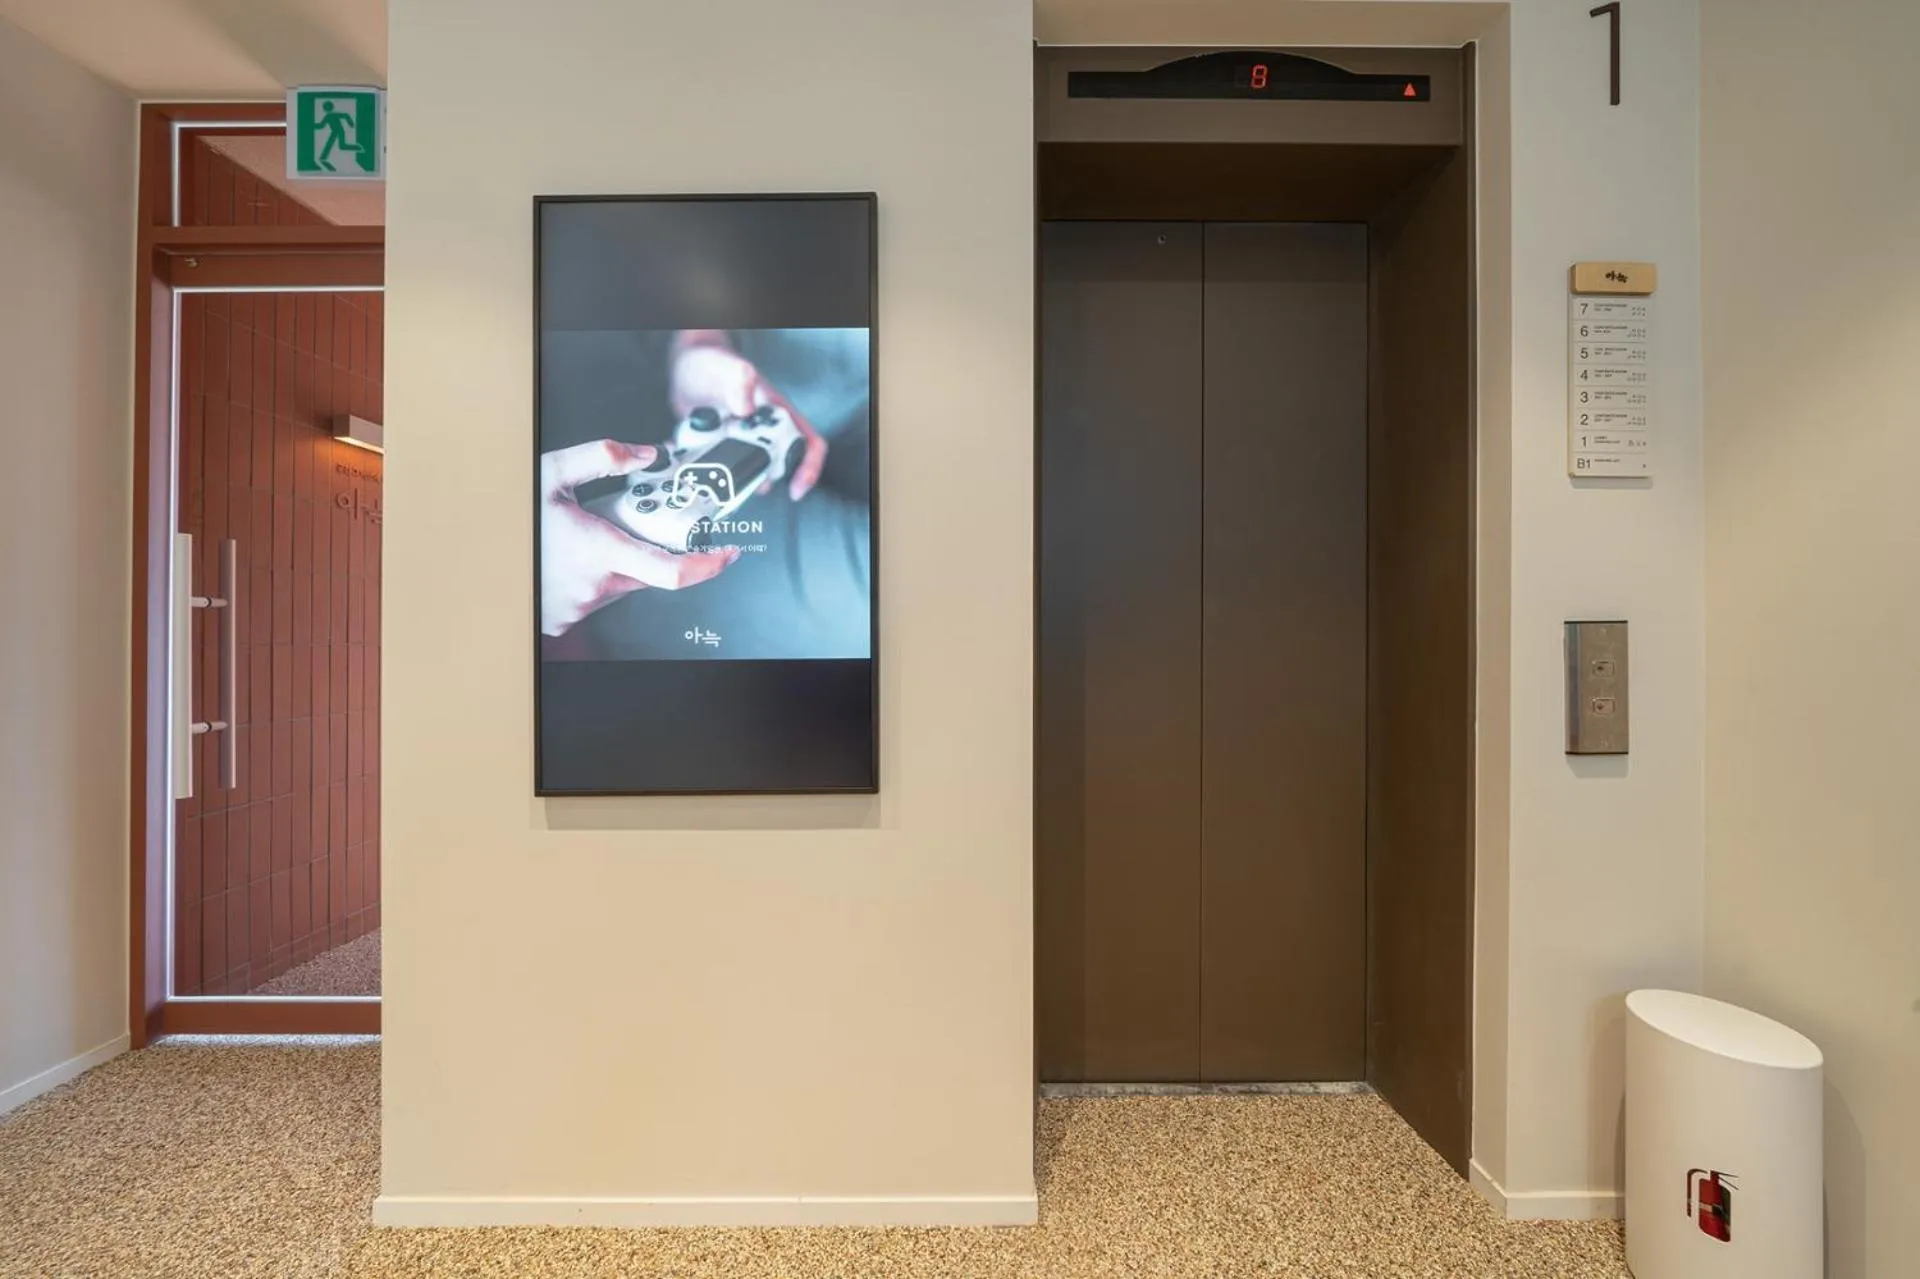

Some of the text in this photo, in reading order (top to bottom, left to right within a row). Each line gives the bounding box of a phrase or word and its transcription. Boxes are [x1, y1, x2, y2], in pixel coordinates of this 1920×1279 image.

[1589, 1, 1620, 106] 1
[1580, 303, 1588, 315] 7
[1580, 325, 1588, 337] 6
[1580, 347, 1588, 359] 5
[1580, 369, 1588, 381] 4
[1580, 391, 1588, 403] 3
[1580, 413, 1588, 426] 2
[1581, 435, 1587, 448] 1
[1577, 458, 1590, 469] B1
[684, 626, 721, 648] 아늑
